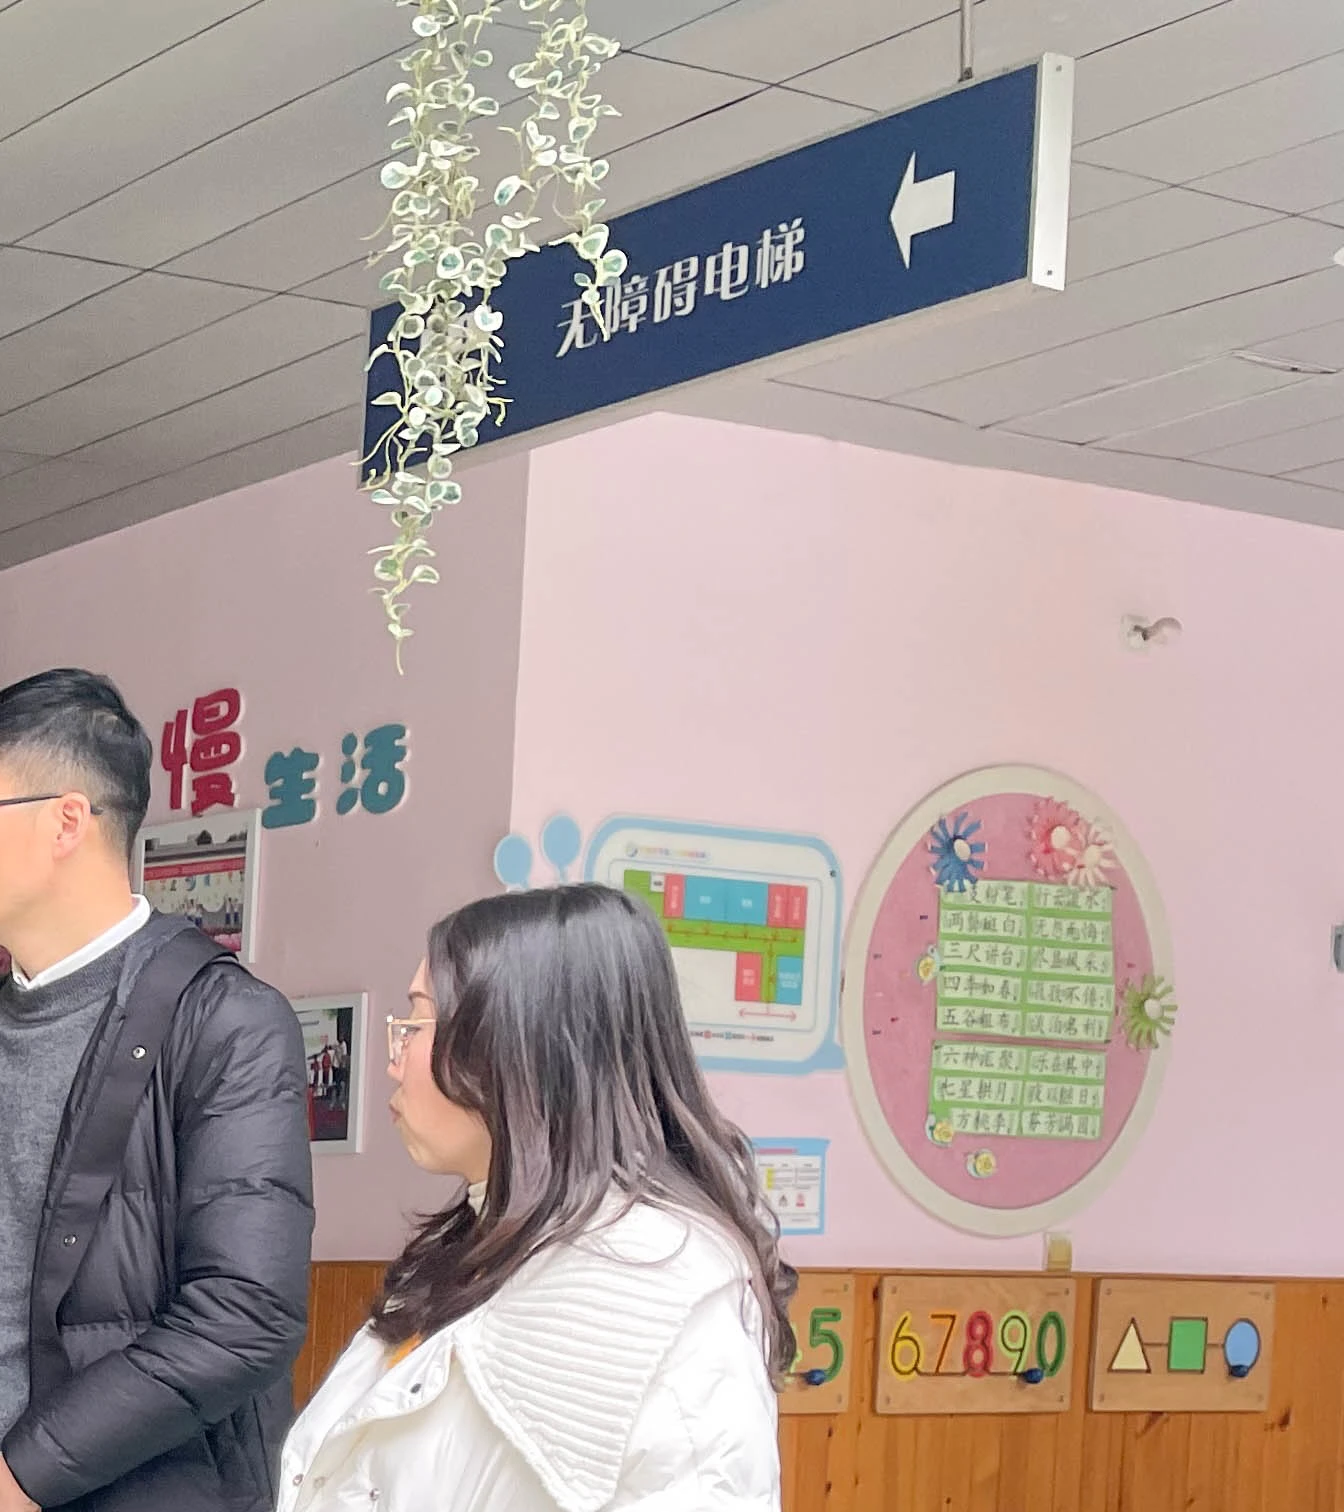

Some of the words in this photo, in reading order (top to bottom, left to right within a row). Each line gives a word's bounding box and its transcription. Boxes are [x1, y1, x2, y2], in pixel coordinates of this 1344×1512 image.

[556, 217, 804, 358] 无障碍电梯
[161, 688, 407, 829] 慢生活
